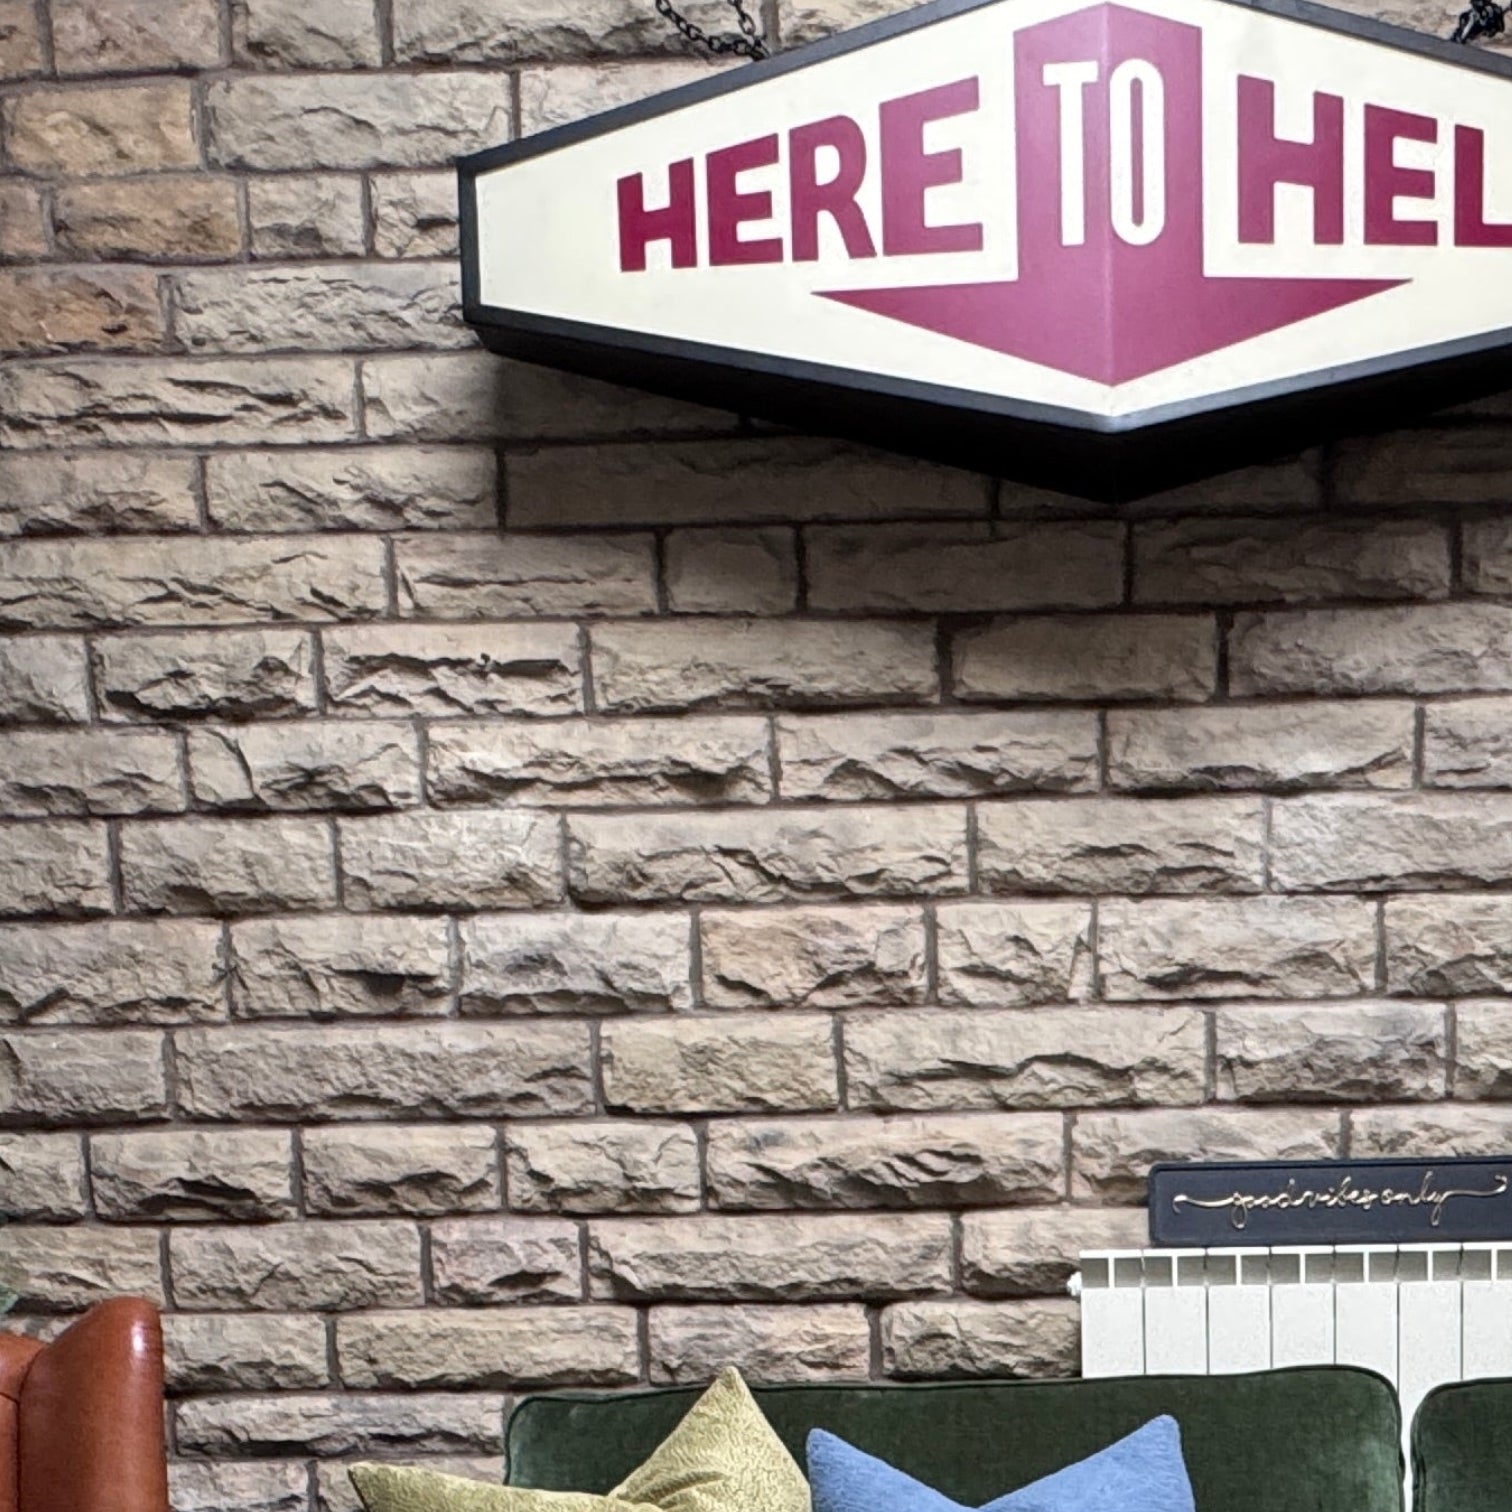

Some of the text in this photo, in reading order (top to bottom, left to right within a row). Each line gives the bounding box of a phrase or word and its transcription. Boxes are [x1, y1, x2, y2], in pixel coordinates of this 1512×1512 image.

[616, 74, 984, 273] HERE
[1042, 58, 1166, 246] TO
[1300, 1175, 1378, 1210] vibes
[1380, 1170, 1508, 1227] only
